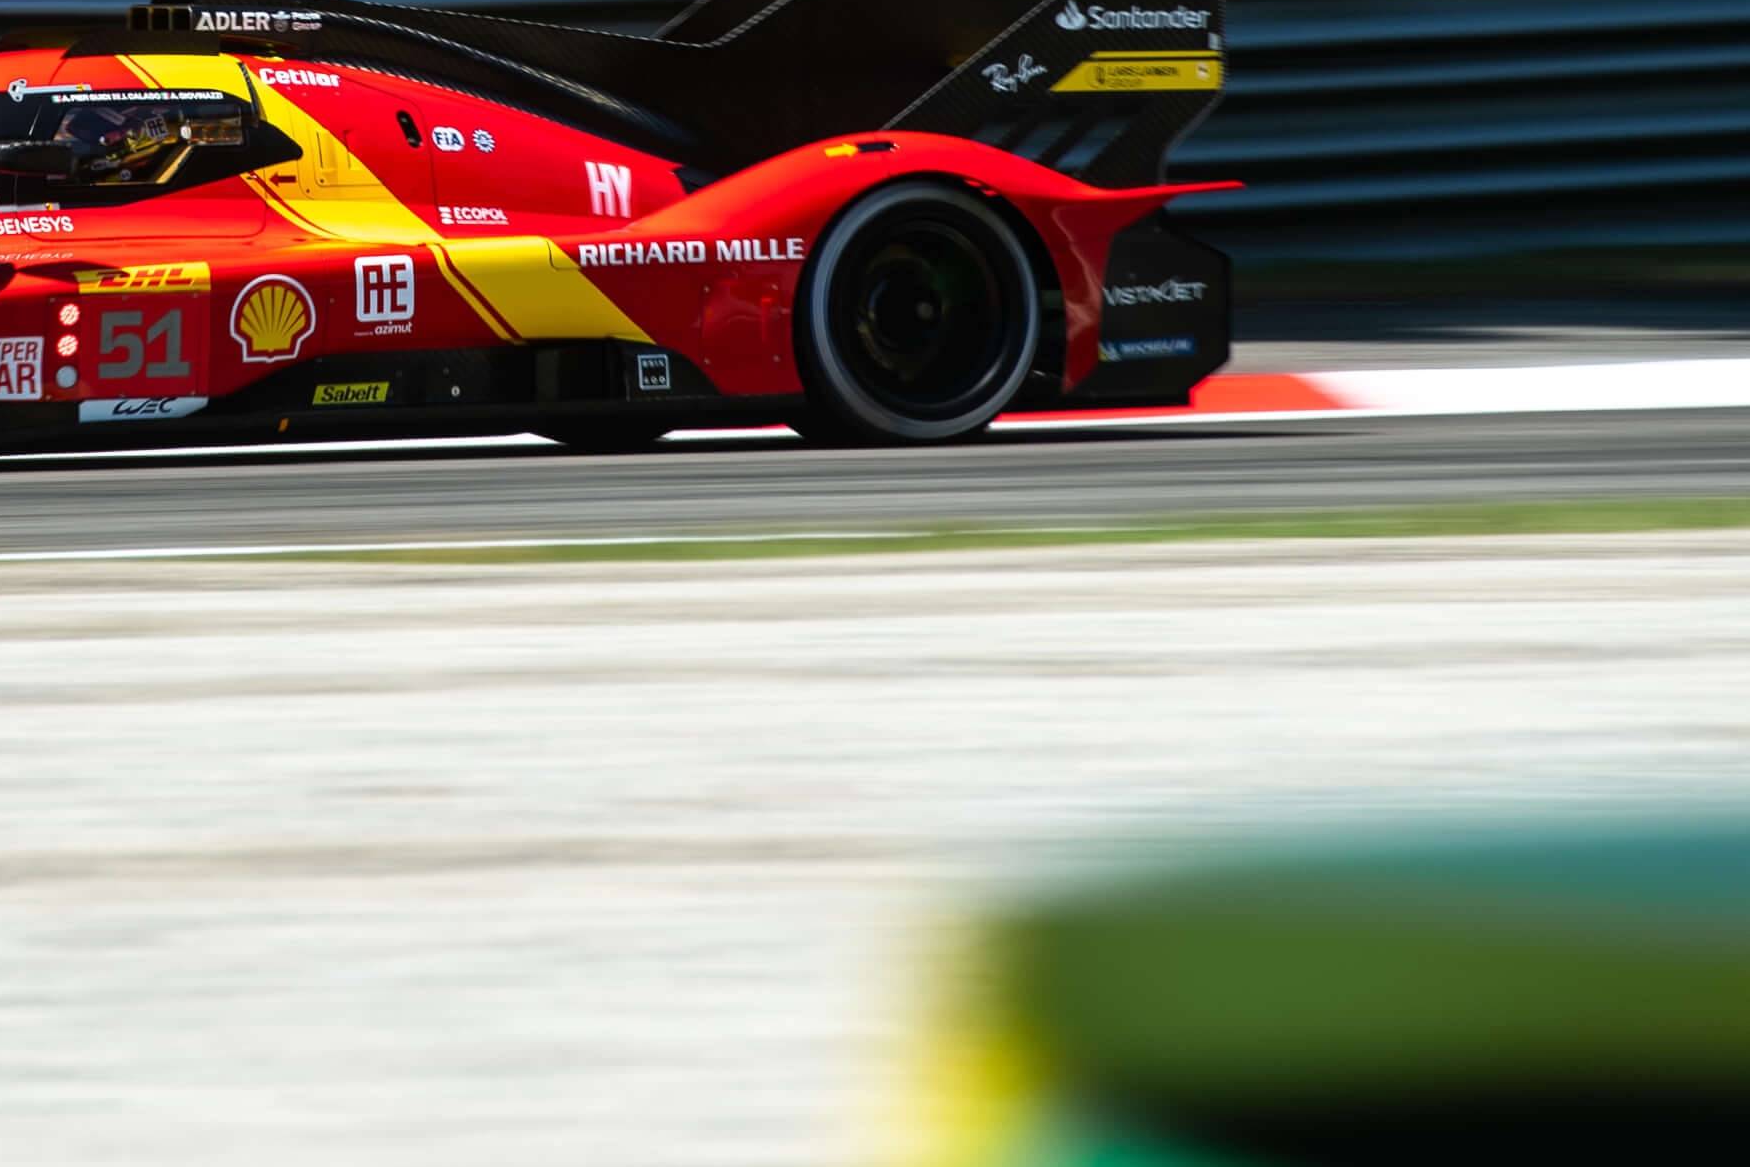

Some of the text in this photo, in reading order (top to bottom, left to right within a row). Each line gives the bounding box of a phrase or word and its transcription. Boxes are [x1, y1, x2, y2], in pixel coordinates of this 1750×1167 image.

[196, 11, 271, 31] ADLER
[1088, 5, 1210, 29] Santander
[453, 206, 509, 221] ECOPOL
[578, 238, 805, 267] RICHARD MILLE
[96, 268, 194, 288] DHL
[374, 321, 413, 336] azimut
[98, 309, 191, 379] 51
[321, 386, 380, 403] Sabelt
